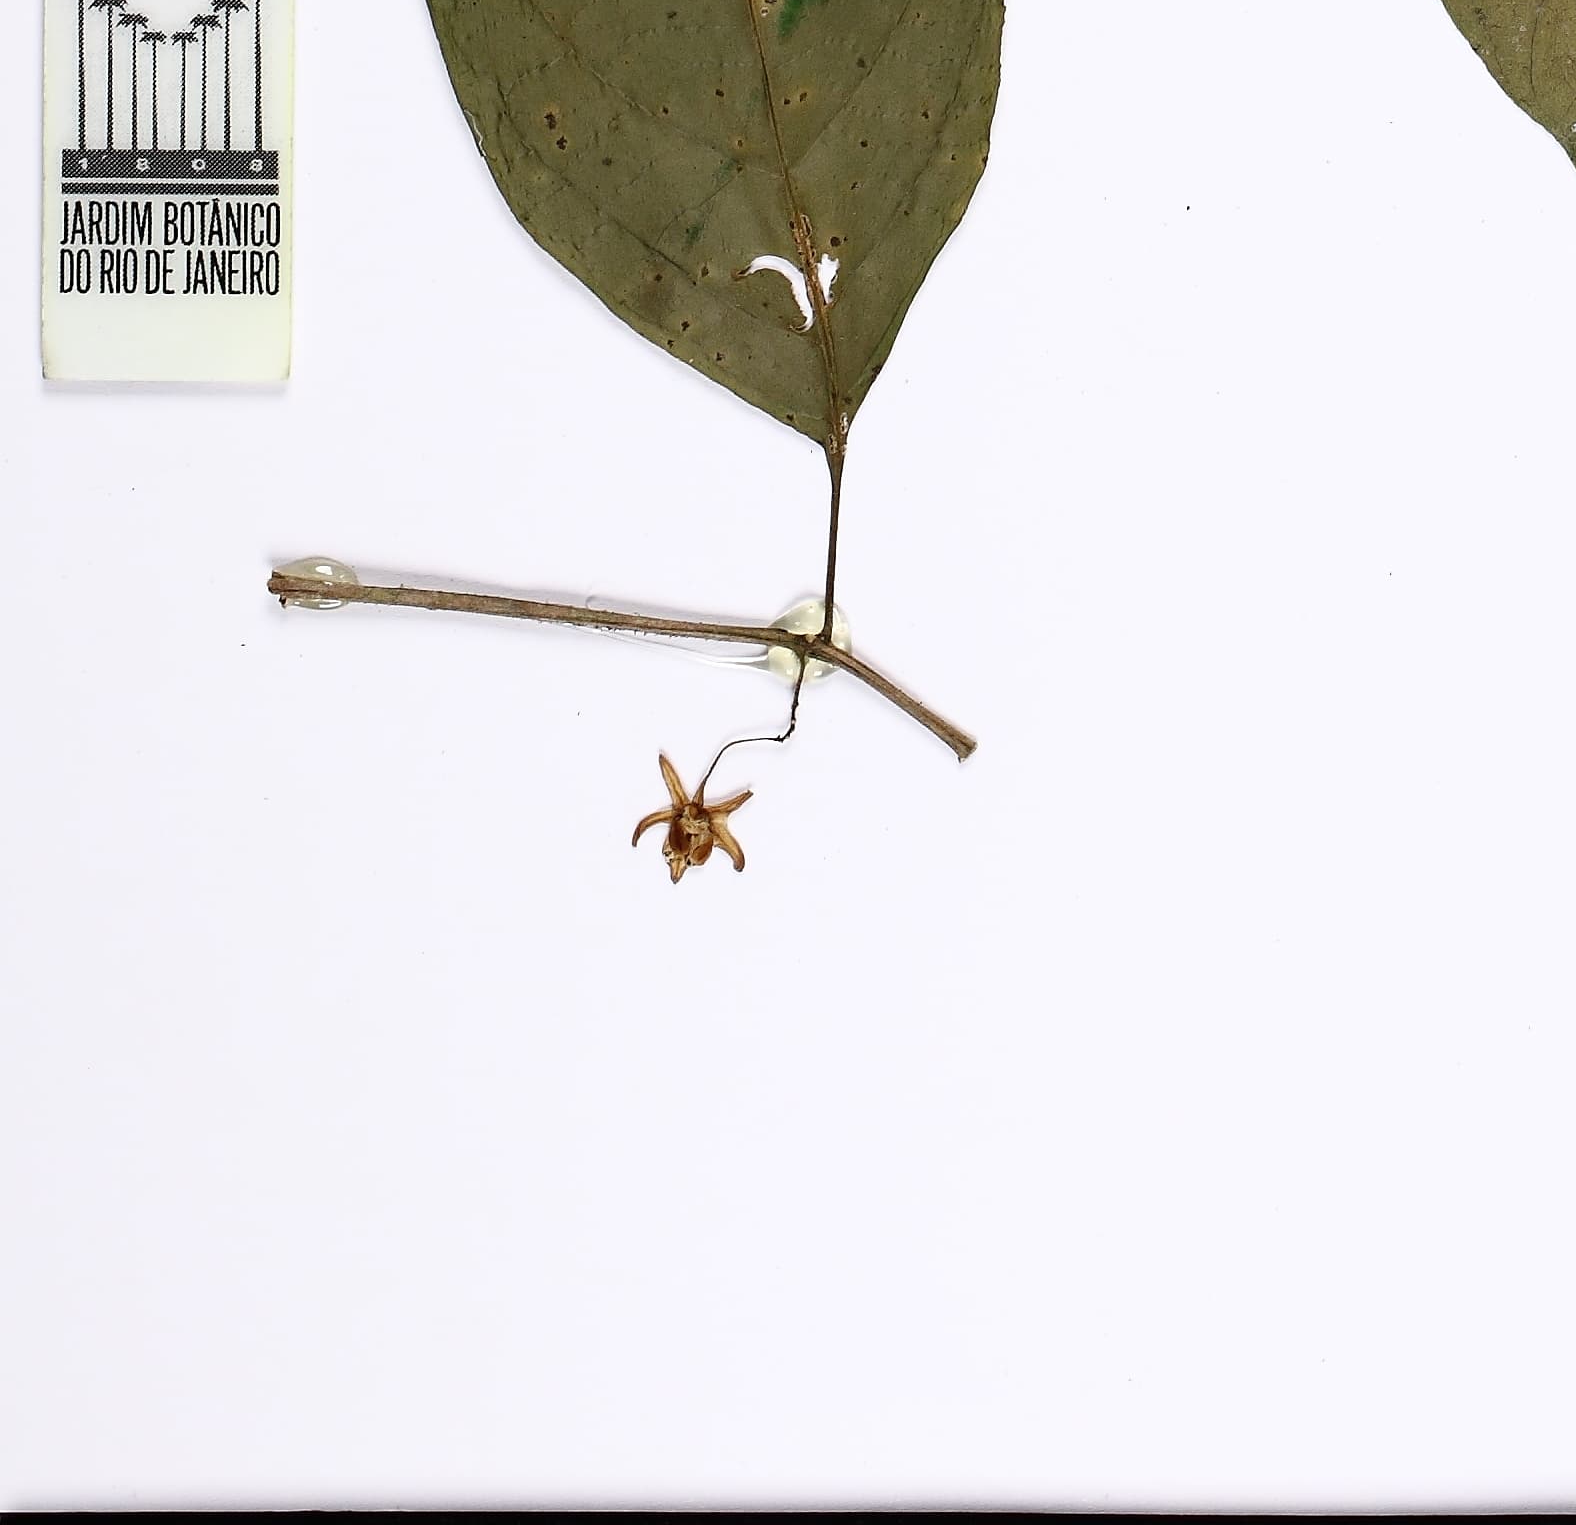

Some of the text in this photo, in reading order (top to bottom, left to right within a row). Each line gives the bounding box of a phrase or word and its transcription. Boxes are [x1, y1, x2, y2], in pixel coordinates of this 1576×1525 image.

[60, 198, 280, 247] JARDIM BOTÂNICO
[60, 248, 280, 296] DO RIO DE JANEIRO
